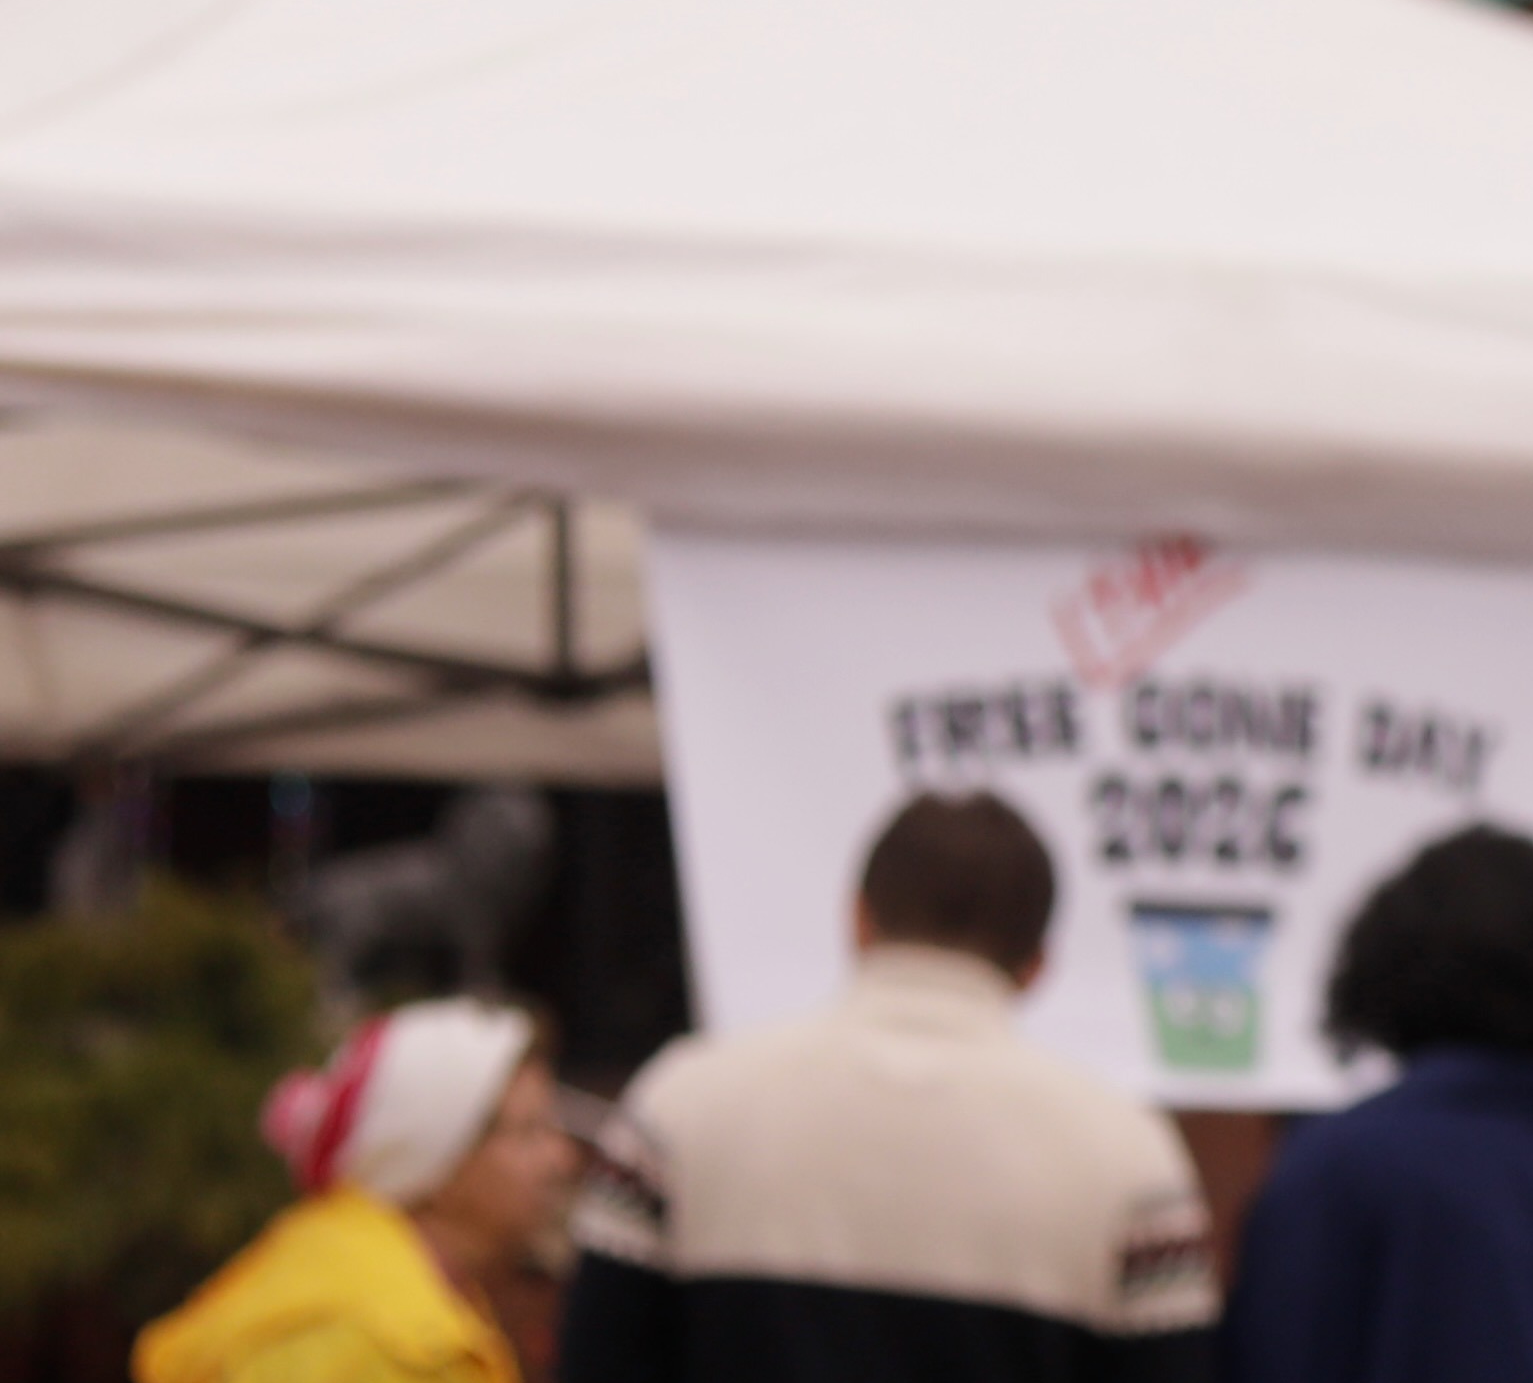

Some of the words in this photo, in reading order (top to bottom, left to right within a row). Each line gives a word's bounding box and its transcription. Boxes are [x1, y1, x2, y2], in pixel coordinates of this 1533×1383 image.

[888, 677, 1087, 769] FREE
[1124, 675, 1323, 759] CONE
[1357, 697, 1500, 793] DAY
